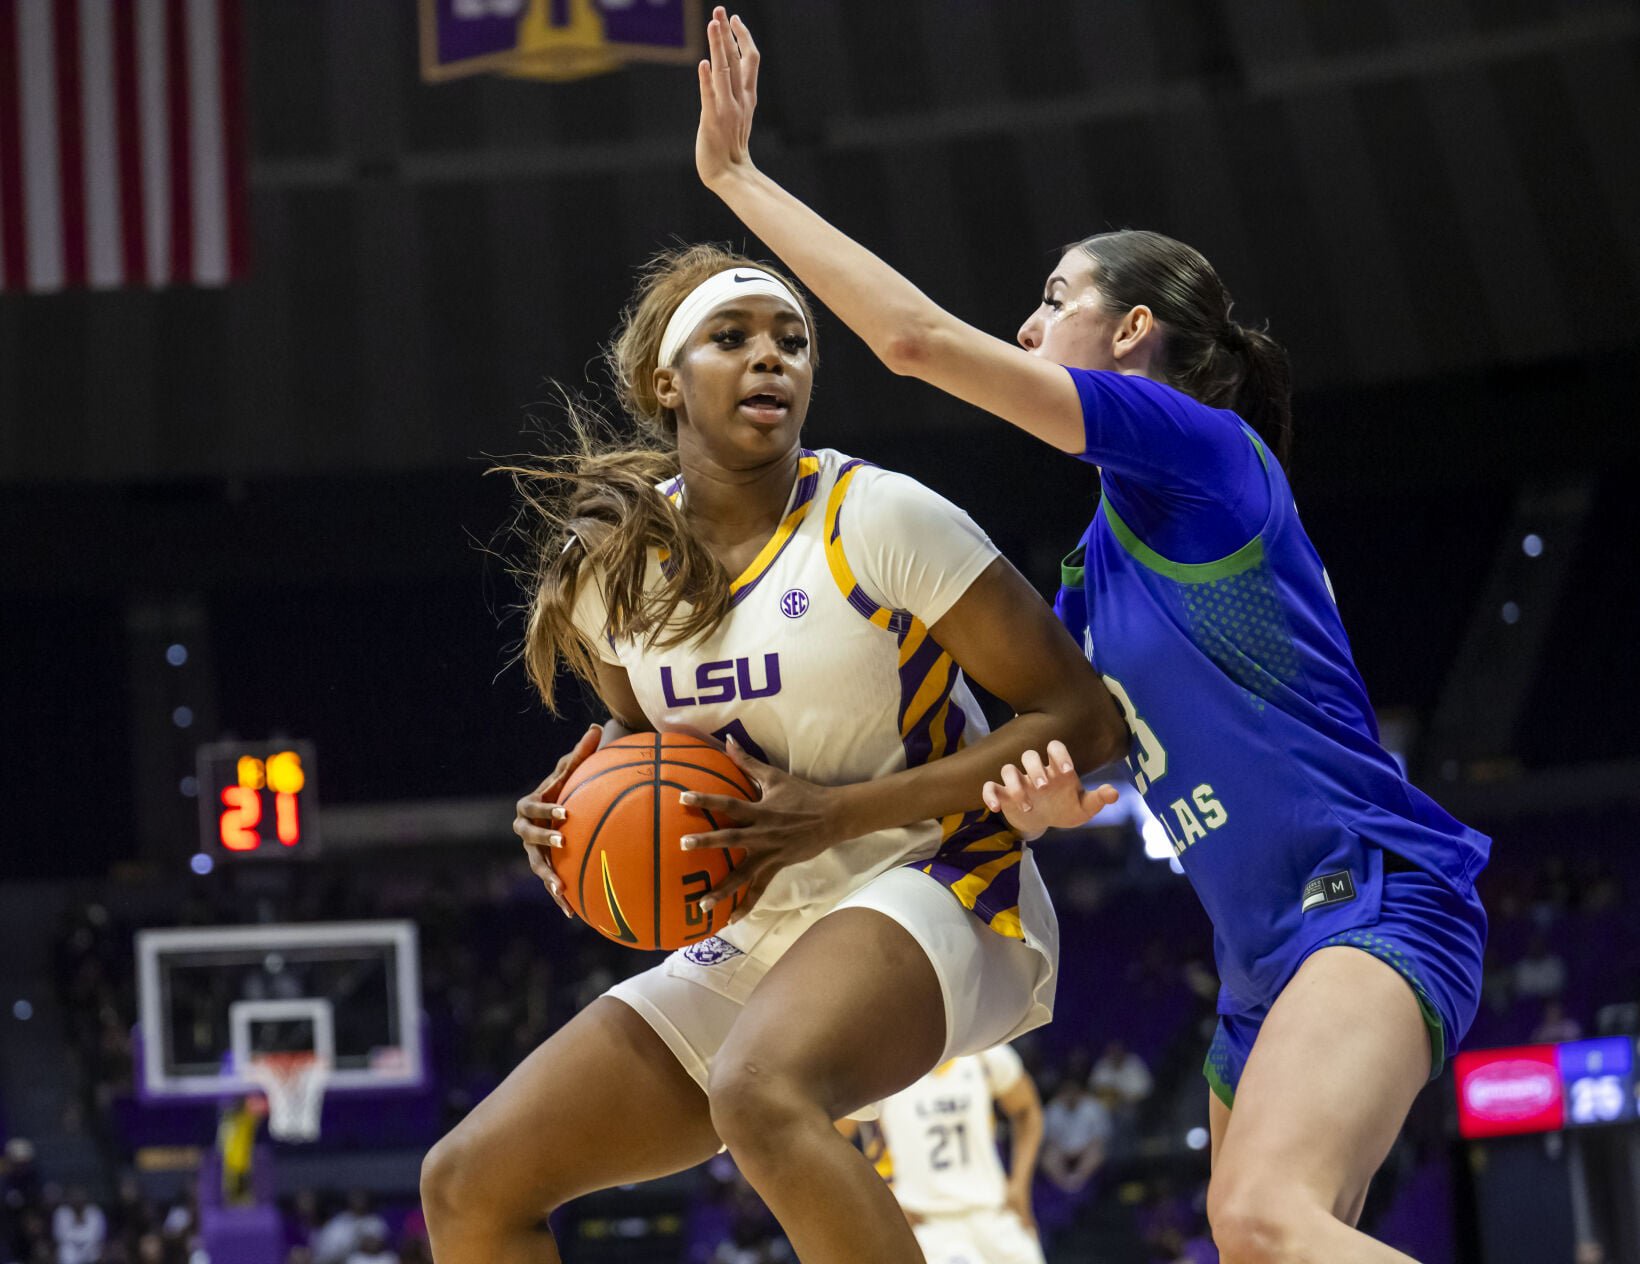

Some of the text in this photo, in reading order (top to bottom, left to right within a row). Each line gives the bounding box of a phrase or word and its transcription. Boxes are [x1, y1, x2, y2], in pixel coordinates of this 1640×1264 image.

[782, 591, 807, 616] SEC
[660, 653, 782, 708] LSU
[1101, 673, 1166, 796] 3
[220, 784, 300, 852] 21
[682, 870, 713, 940] LSU
[1331, 880, 1345, 893] M
[926, 1124, 970, 1171] 21
